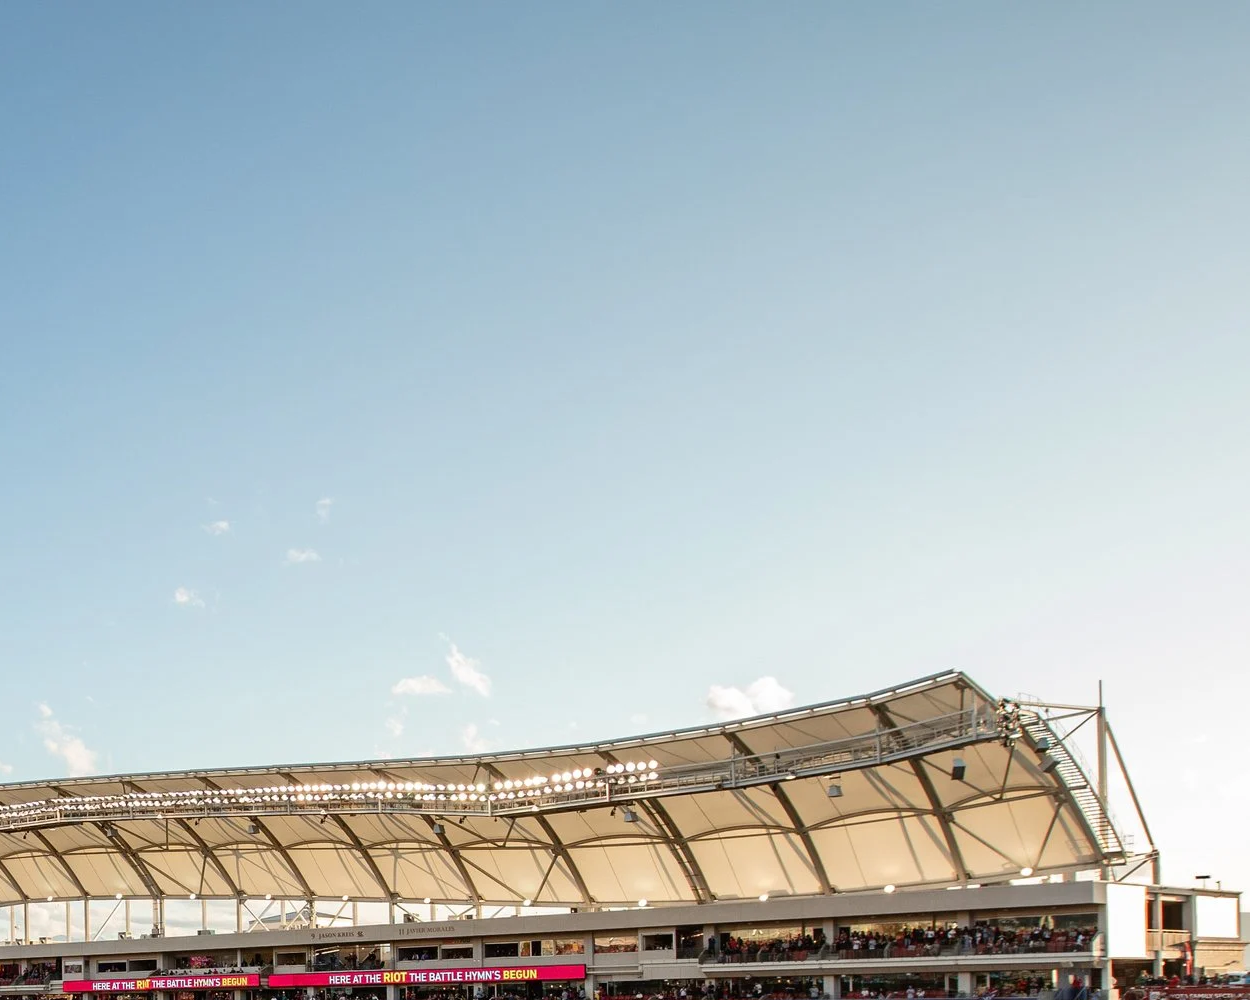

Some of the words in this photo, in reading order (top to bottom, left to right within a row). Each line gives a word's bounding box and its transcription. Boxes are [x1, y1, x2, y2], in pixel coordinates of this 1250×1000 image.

[406, 928, 427, 936] JAVIER
[427, 926, 456, 934] MORALES
[92, 982, 111, 991] HERE
[112, 981, 121, 990] AT
[121, 981, 135, 990] THE
[152, 980, 165, 988] THE
[167, 978, 193, 988] BATTLE
[193, 977, 221, 988] HYMN'S
[221, 977, 248, 987] BEGUN
[329, 975, 351, 985] HERE
[353, 974, 364, 984] AT
[364, 973, 382, 984] THE
[383, 972, 408, 983] RIOT
[409, 972, 427, 982] THE
[429, 971, 463, 982] BATTLE
[465, 970, 501, 981] HYMN'S
[503, 969, 538, 980] BEGUN
